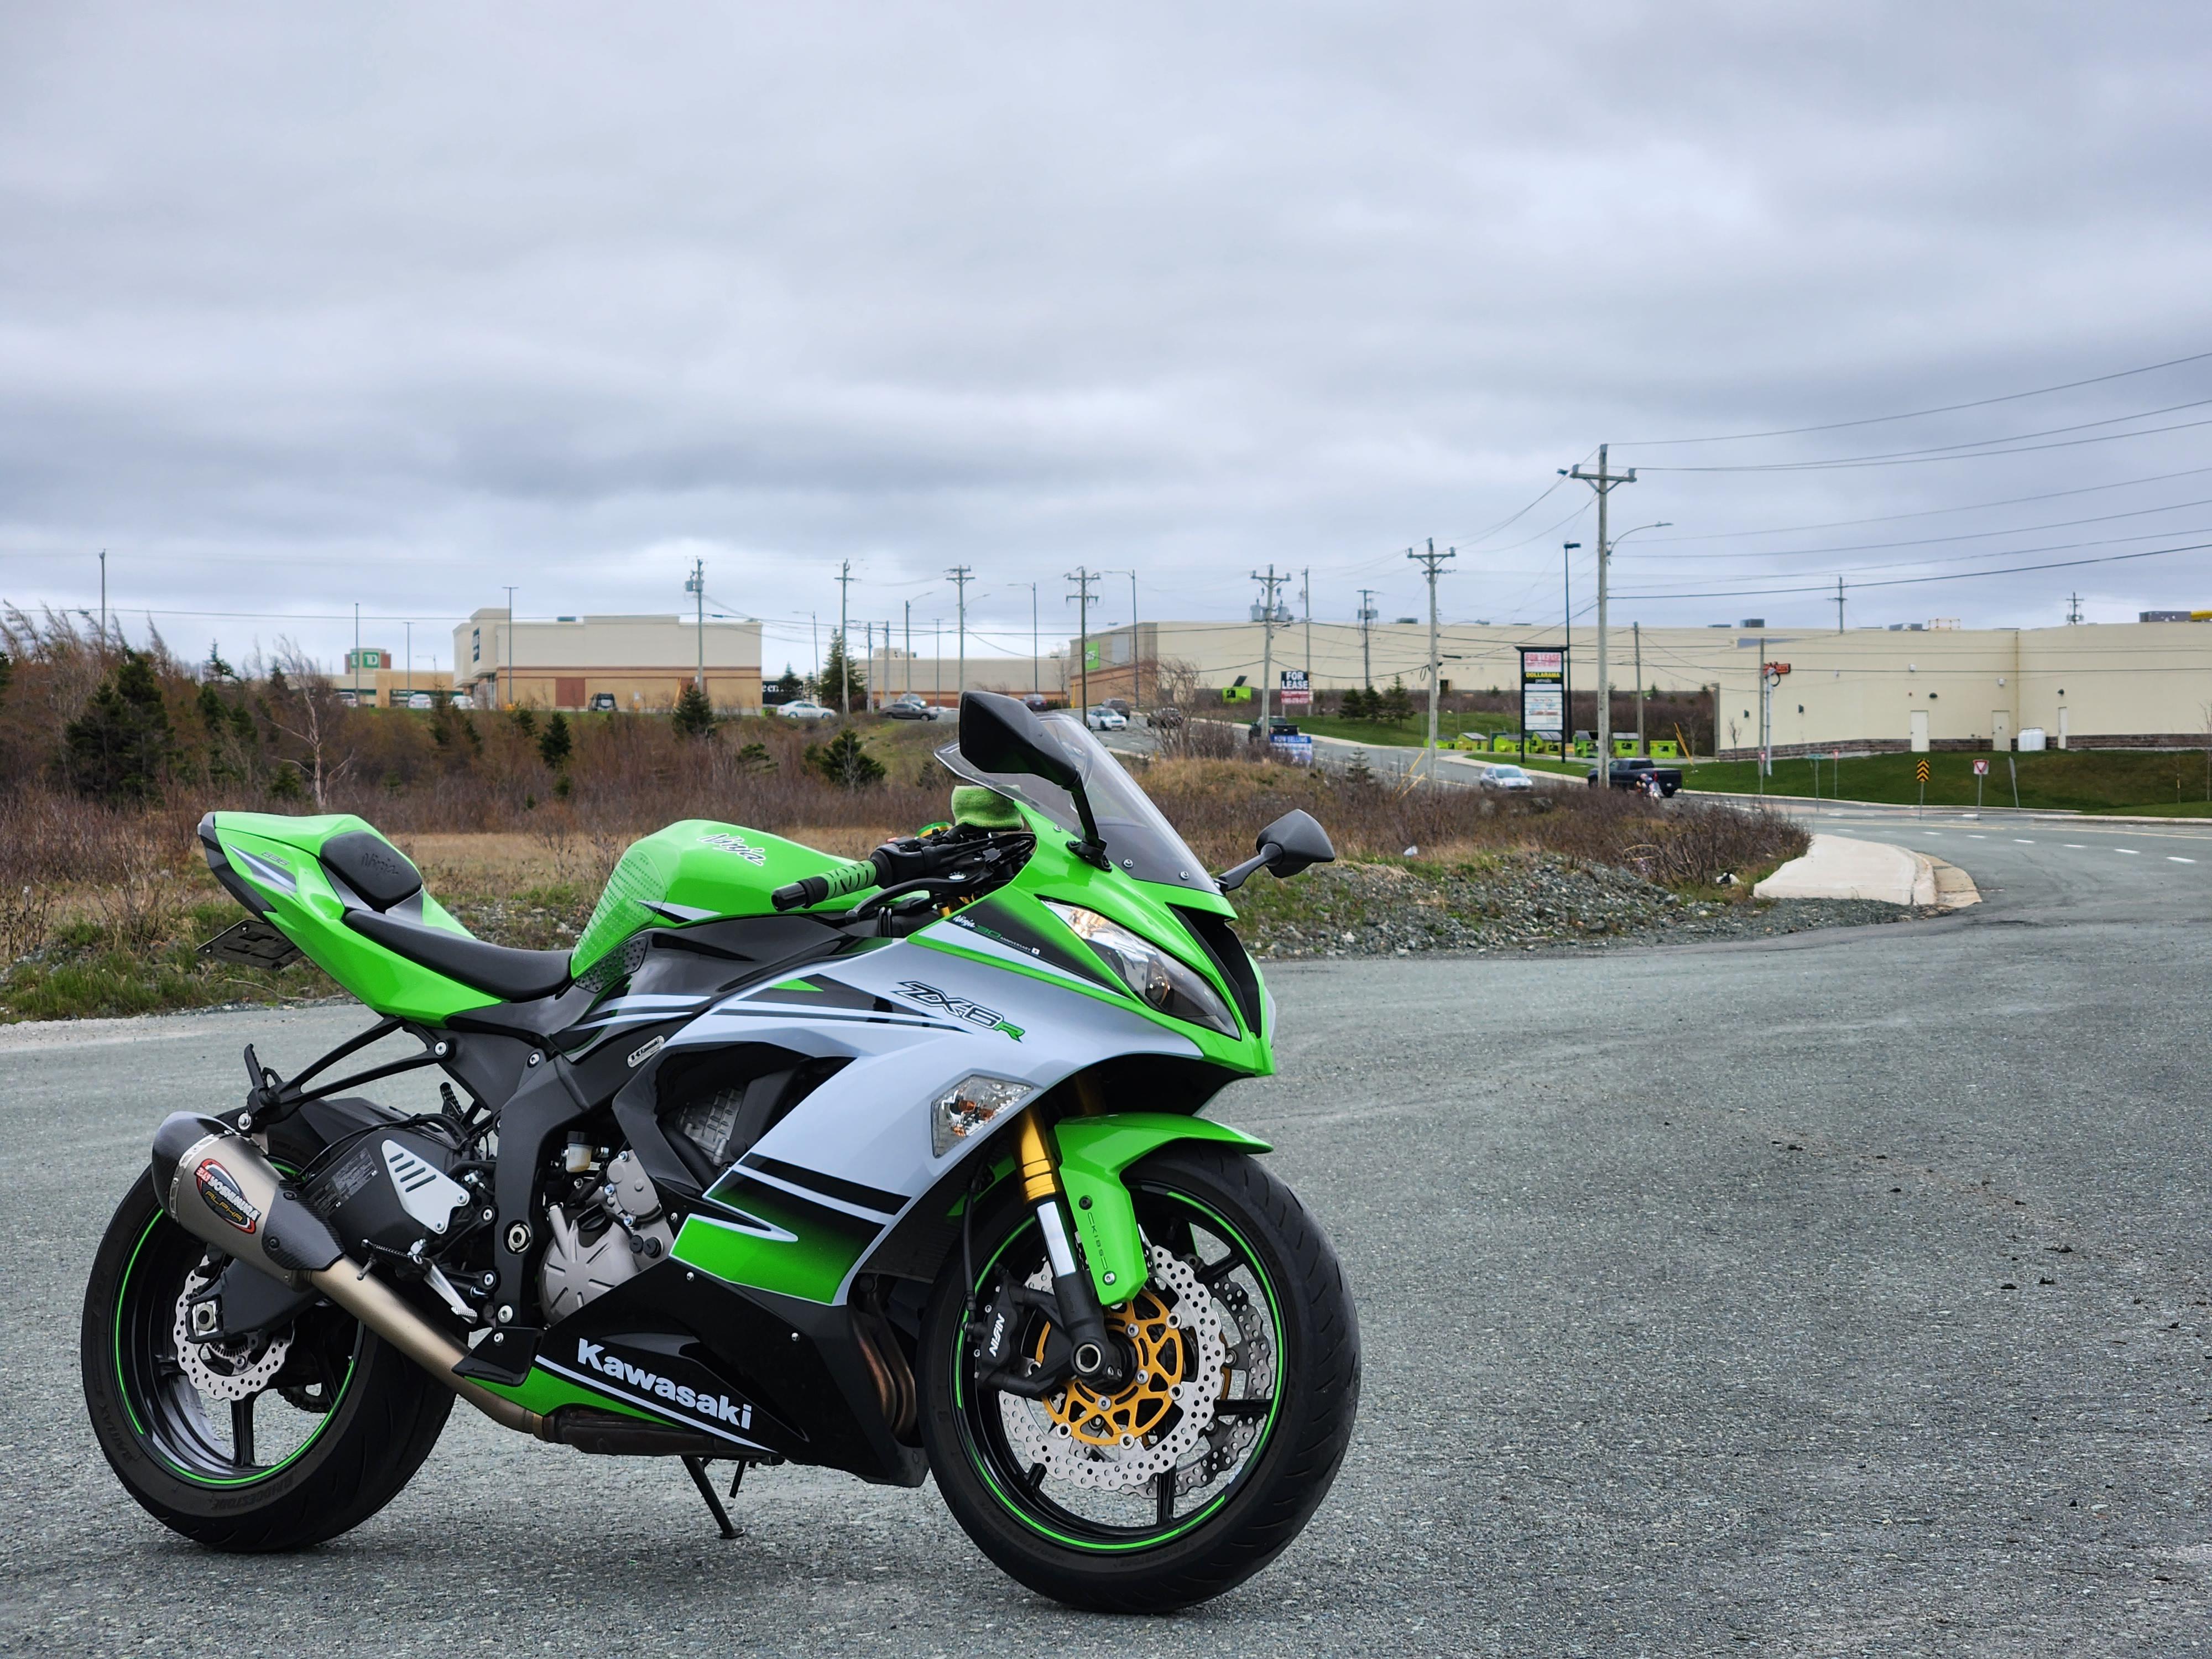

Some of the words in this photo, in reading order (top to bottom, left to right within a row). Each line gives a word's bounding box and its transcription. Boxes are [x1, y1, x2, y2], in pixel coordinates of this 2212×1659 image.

[365, 654, 378, 665] TD
[1286, 671, 1303, 680] FOR
[1282, 680, 1308, 690] LEASE
[361, 853, 399, 875] Ninja
[697, 833, 766, 866] Ninja
[952, 915, 976, 928] Ninja
[999, 936, 1031, 952] ANNIVERSARY
[205, 1190, 243, 1222] ALPHA
[208, 1176, 259, 1222] YOSHIMURA
[988, 1312, 1005, 1358] NISSIN
[578, 1338, 752, 1430] Kawasaki
